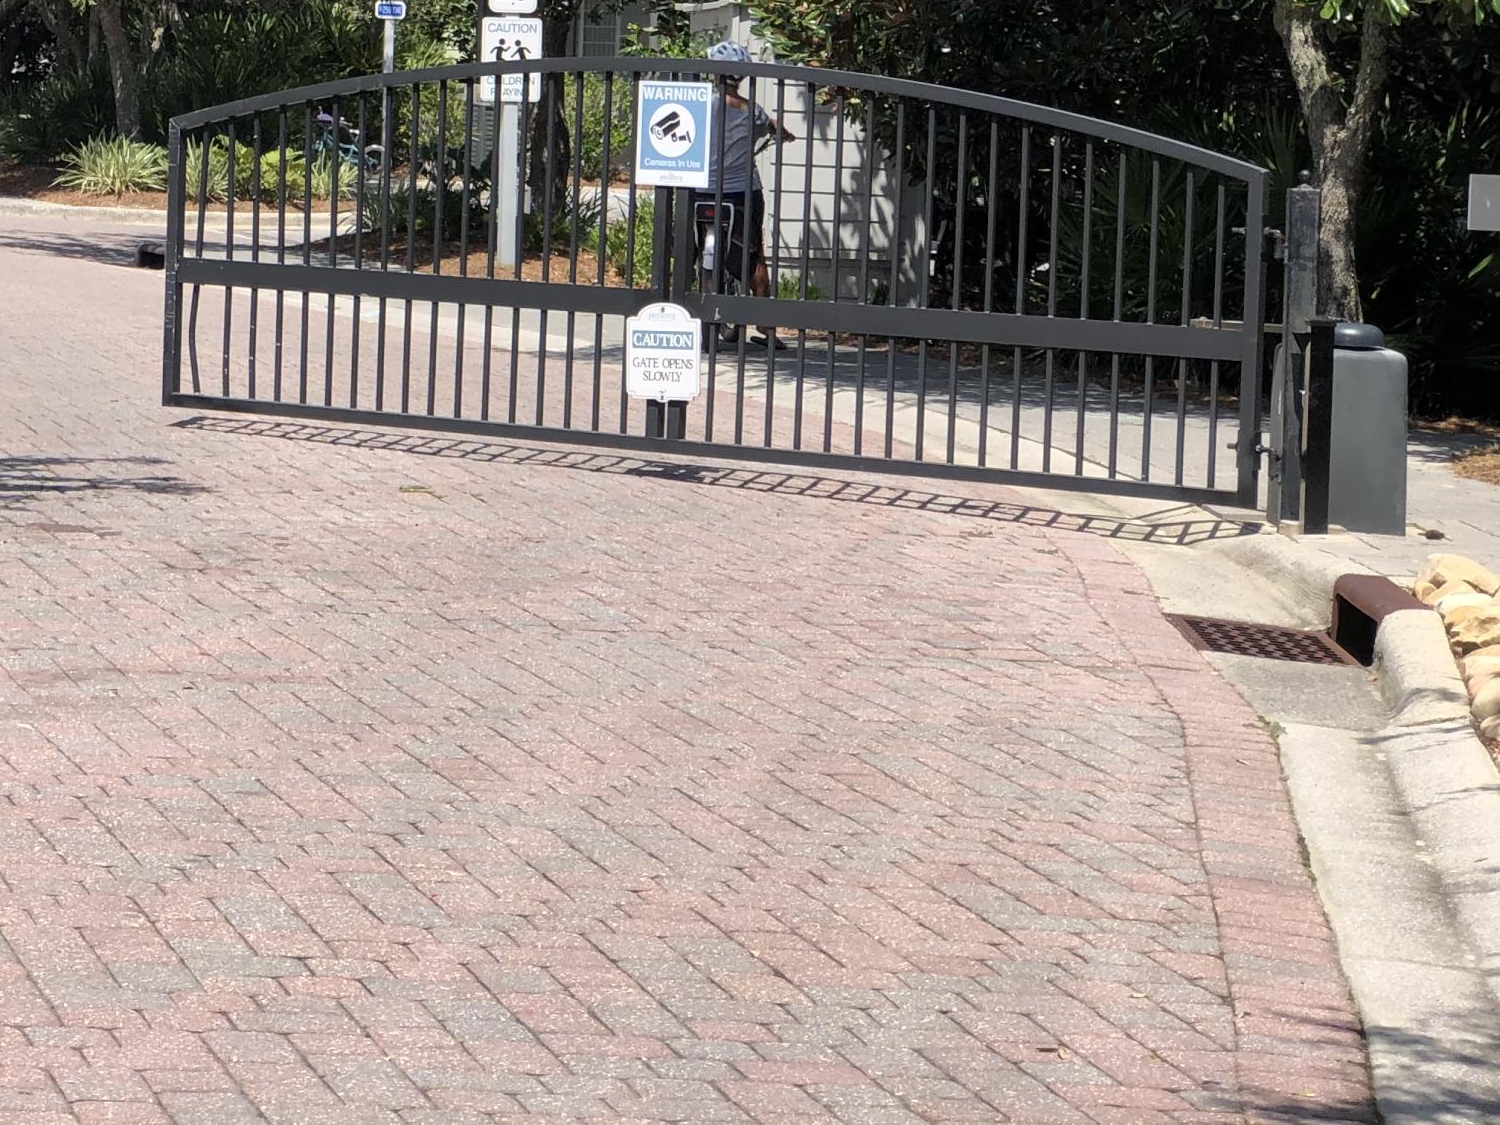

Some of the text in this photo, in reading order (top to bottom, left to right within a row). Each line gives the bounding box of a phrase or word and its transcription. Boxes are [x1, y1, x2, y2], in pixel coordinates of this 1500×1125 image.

[487, 23, 538, 34] CAUTION
[486, 76, 536, 86] CLDRN
[643, 87, 707, 101] WARNING
[644, 157, 677, 167] Cameras
[686, 159, 701, 168] Use
[633, 332, 693, 348] CAUTION
[632, 357, 694, 369] GATE OPENS
[642, 371, 682, 382] SLOWLY
